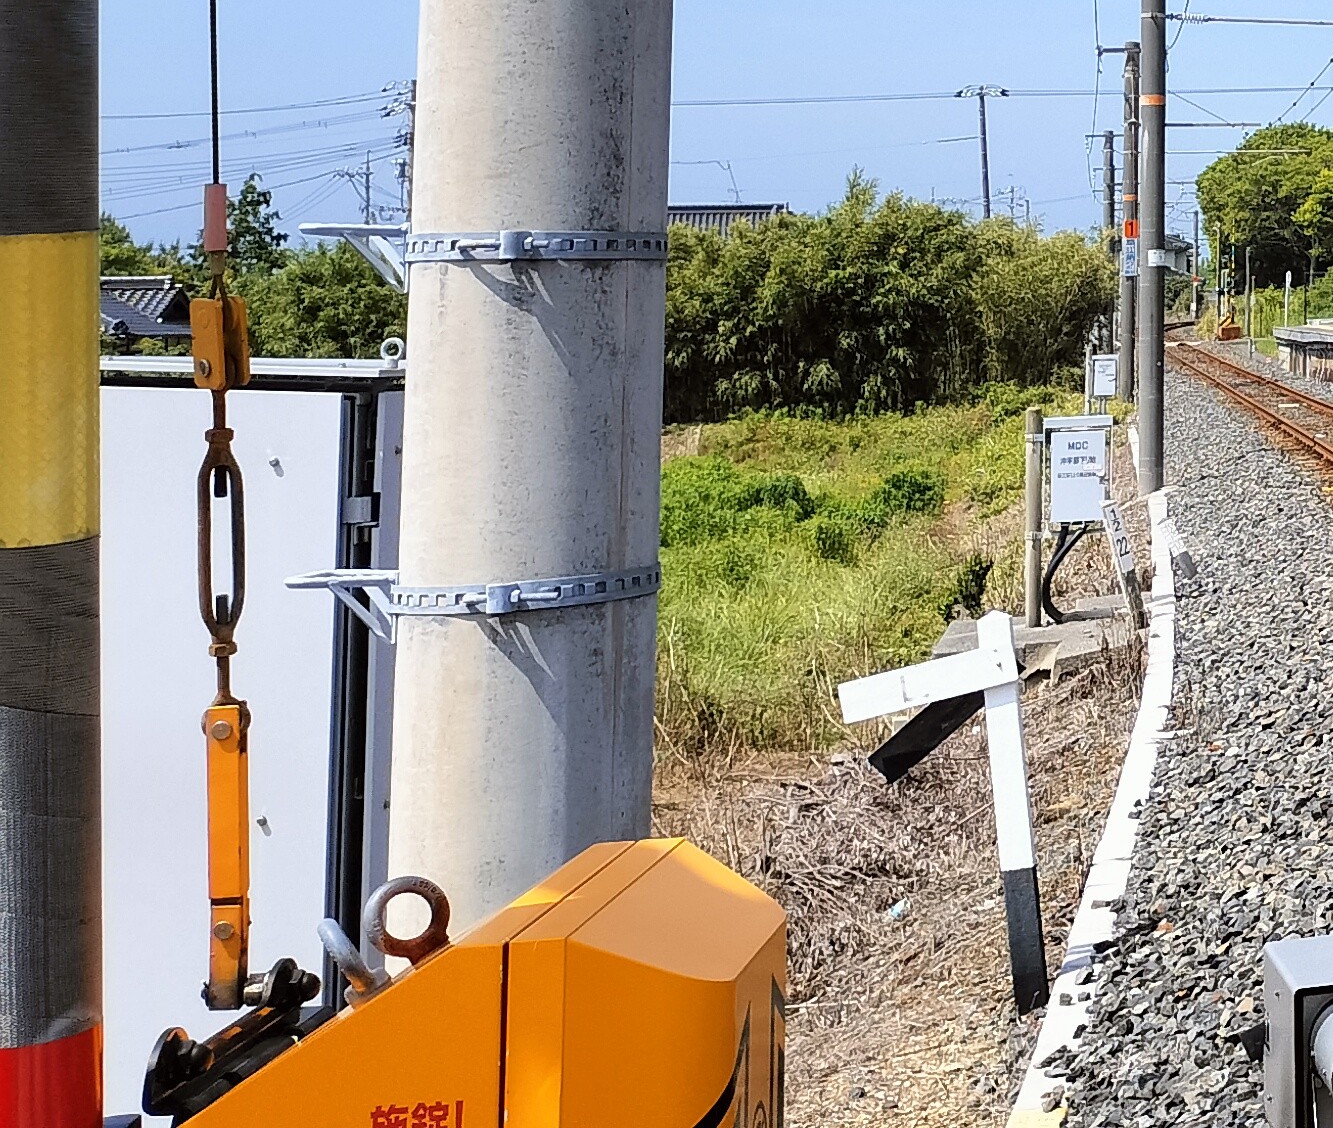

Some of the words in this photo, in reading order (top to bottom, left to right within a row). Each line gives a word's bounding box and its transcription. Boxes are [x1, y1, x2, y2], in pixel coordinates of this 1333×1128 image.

[1128, 221, 1134, 237] 1
[1067, 440, 1089, 450] MDC
[1116, 536, 1130, 557] 22
